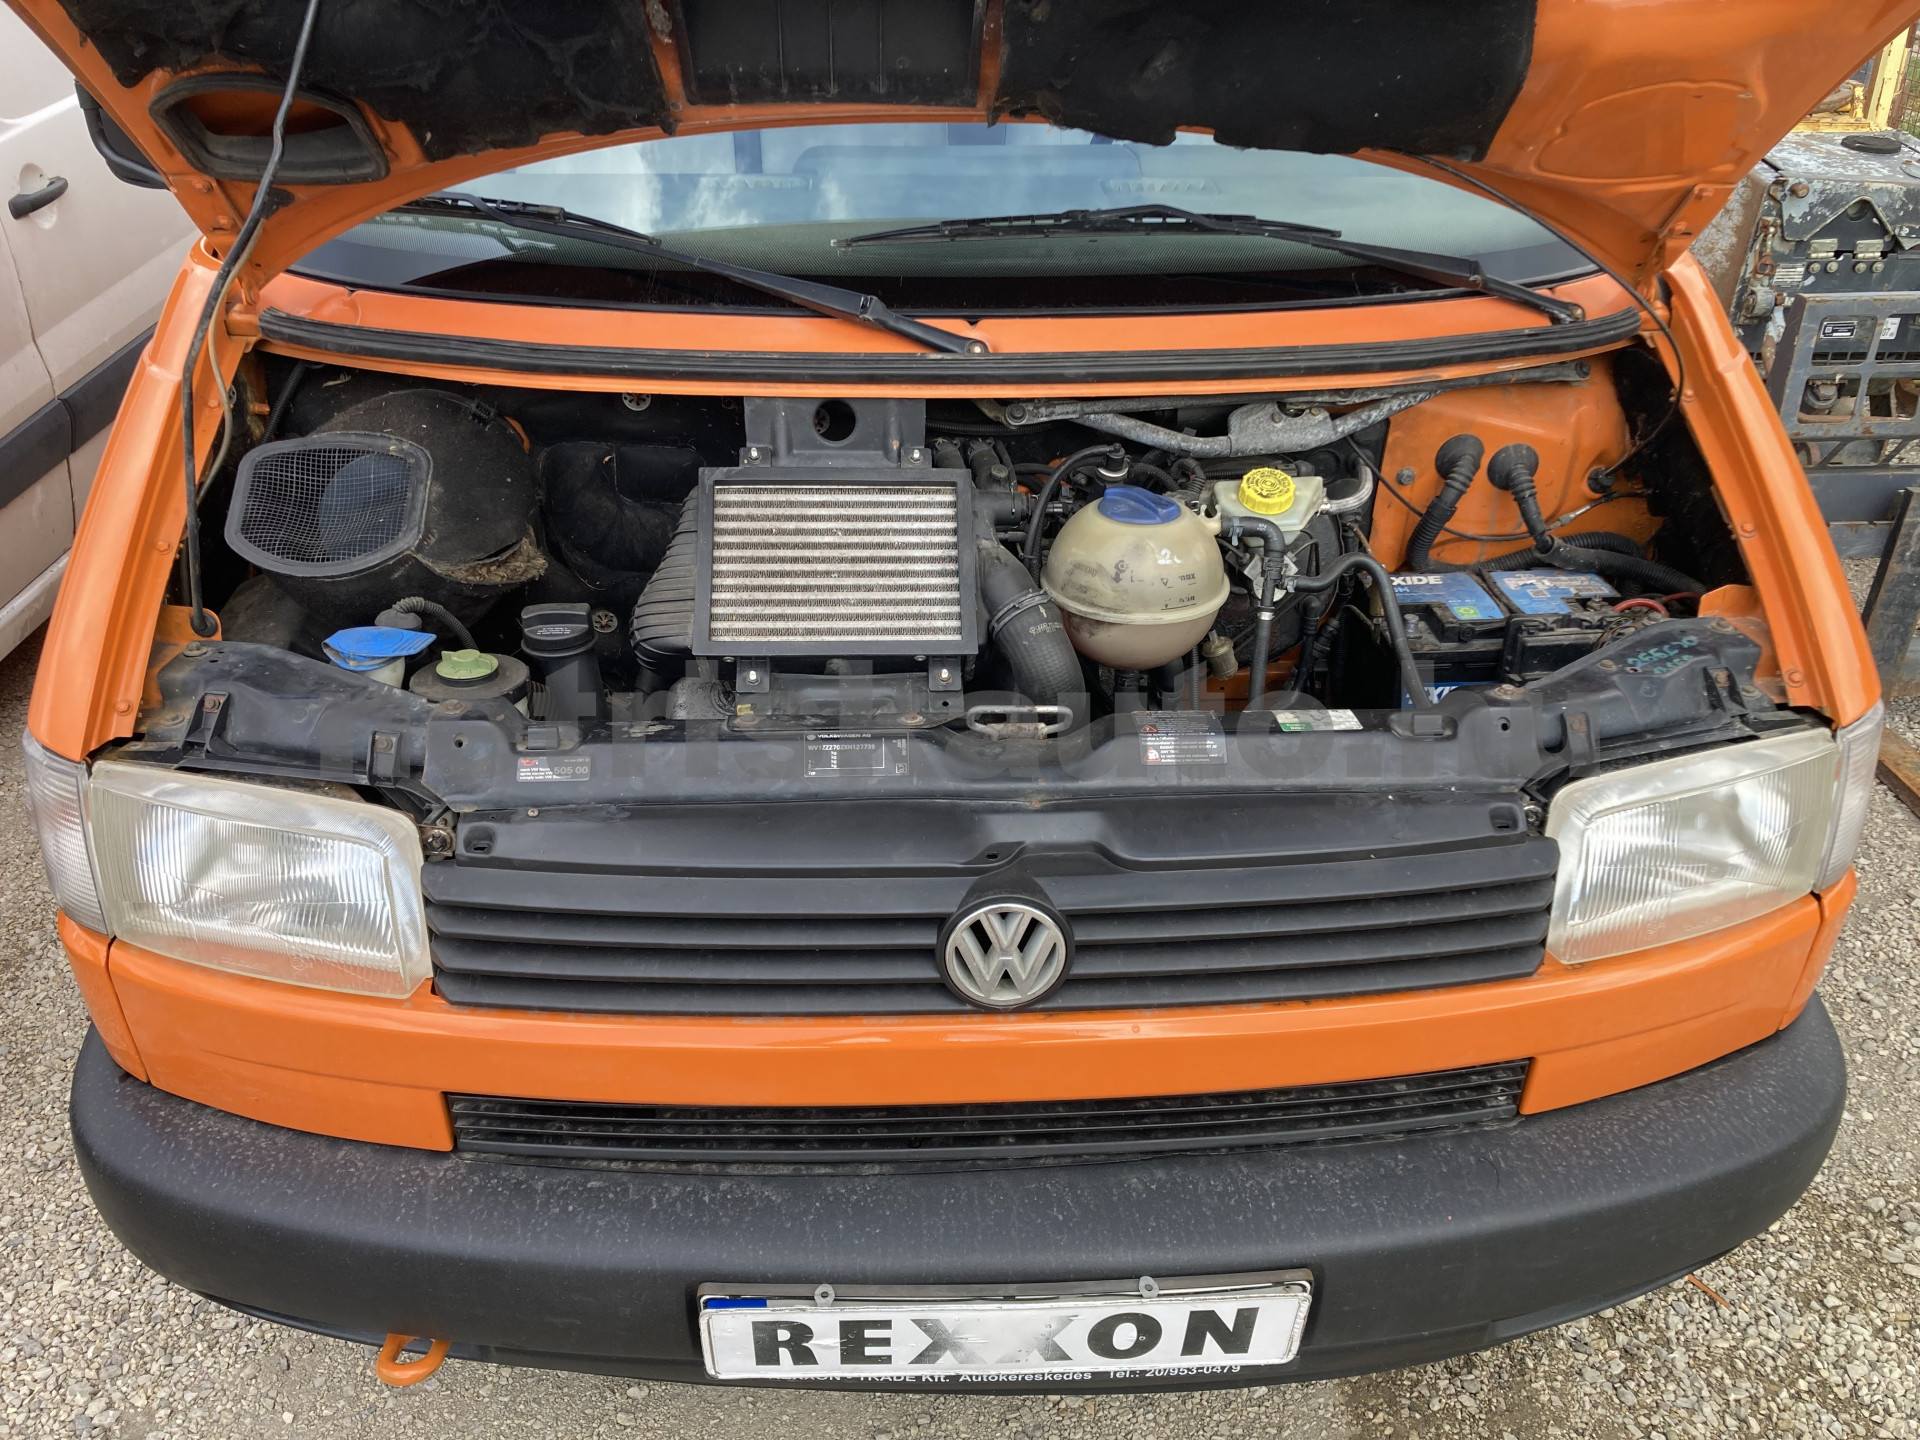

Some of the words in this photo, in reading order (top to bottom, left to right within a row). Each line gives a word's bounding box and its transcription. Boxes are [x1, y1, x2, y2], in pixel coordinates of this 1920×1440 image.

[1390, 576, 1443, 585] XIDE
[554, 766, 573, 775] 505
[575, 766, 589, 774] 00
[752, 1307, 1260, 1366] REXXON
[921, 1373, 950, 1382] Kft.
